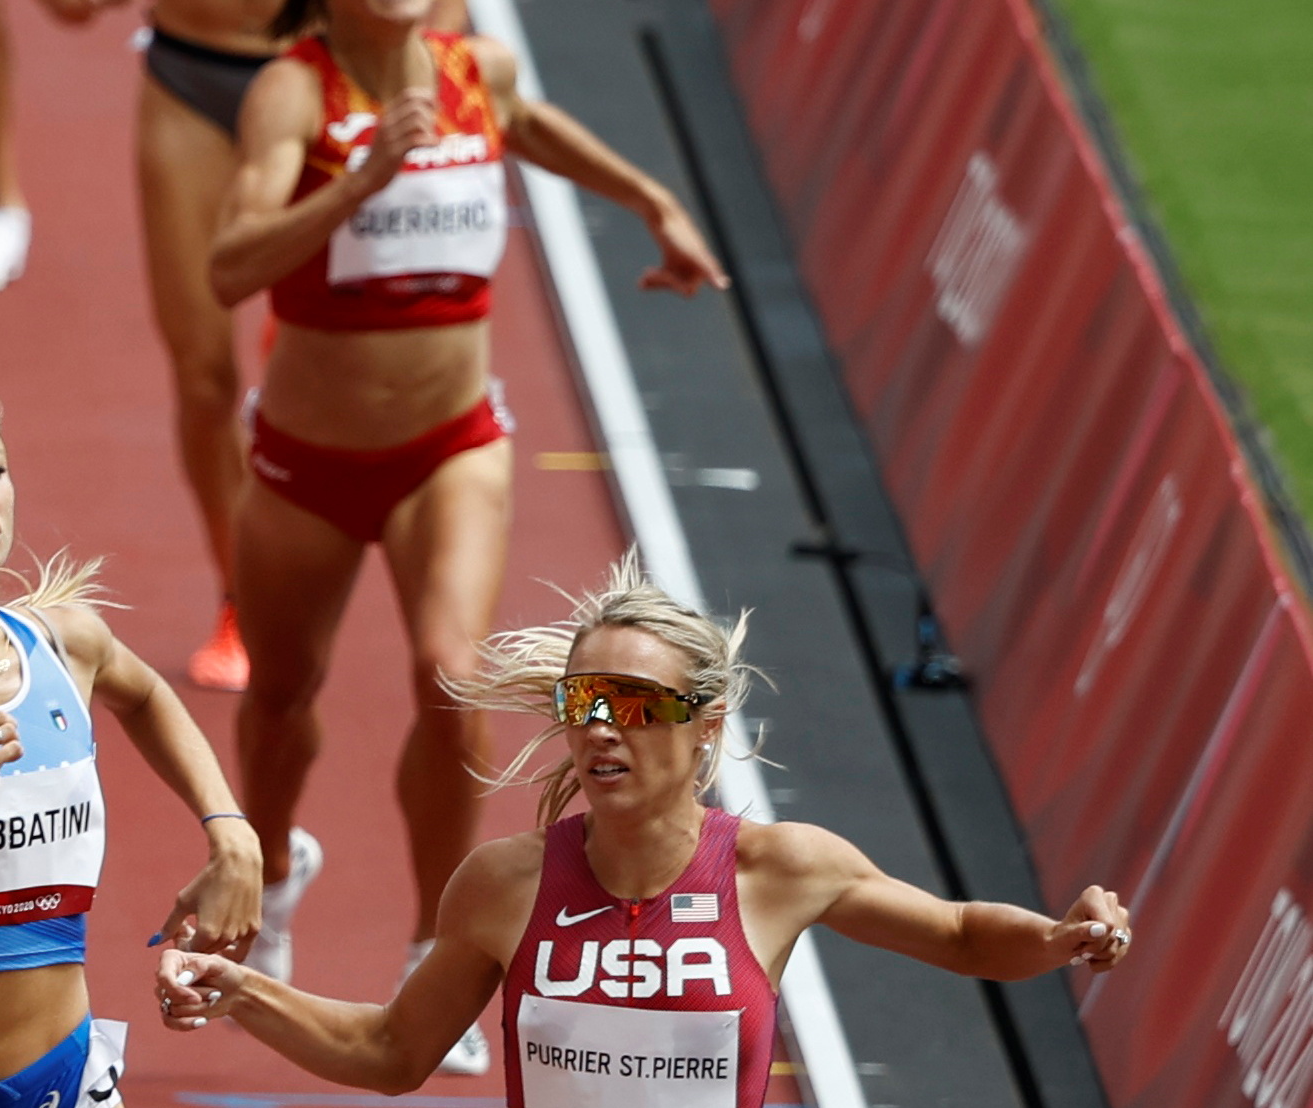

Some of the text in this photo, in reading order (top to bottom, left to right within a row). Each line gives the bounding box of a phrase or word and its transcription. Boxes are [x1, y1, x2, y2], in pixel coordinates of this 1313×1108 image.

[534, 937, 732, 998] USA
[527, 1041, 729, 1080] PURRIER ST.PIERRE
